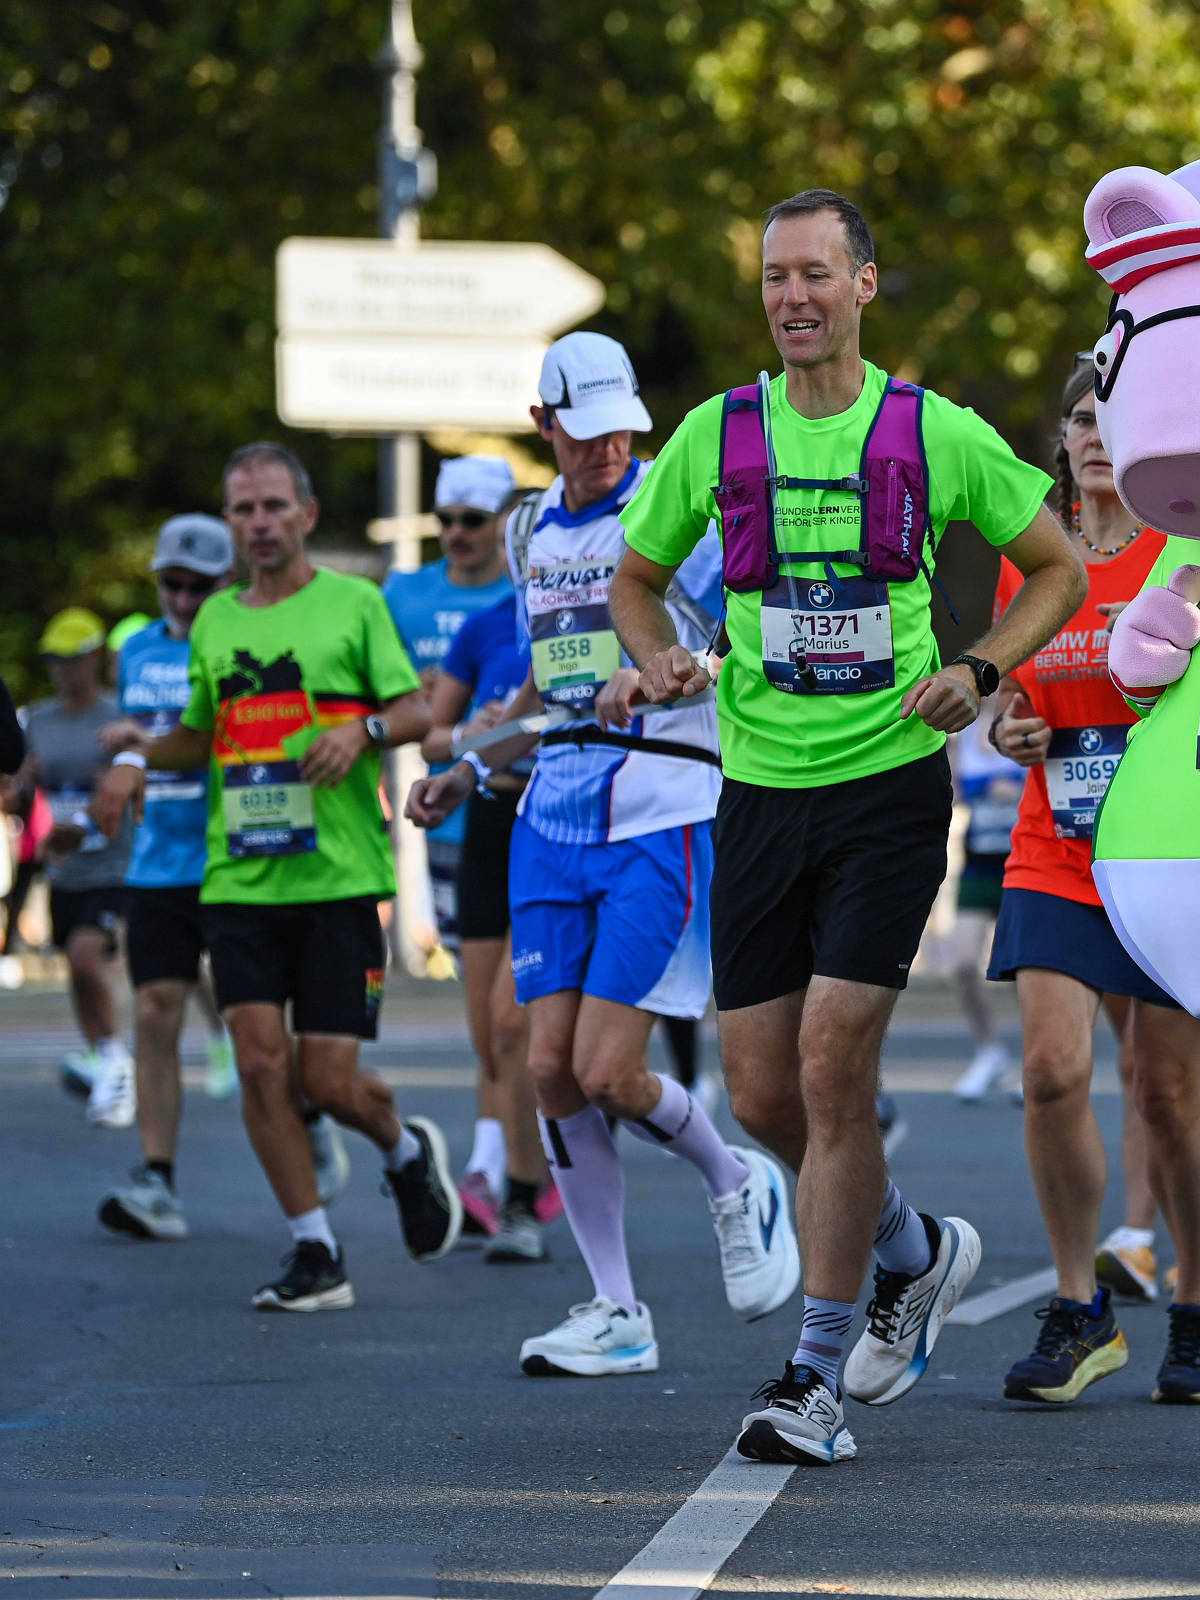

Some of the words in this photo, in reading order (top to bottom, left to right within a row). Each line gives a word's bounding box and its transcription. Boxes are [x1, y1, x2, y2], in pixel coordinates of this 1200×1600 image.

[791, 613, 859, 636] 71371
[549, 638, 590, 662] 5558
[804, 637, 850, 650] Marius
[1034, 652, 1088, 669] BERLIN
[793, 667, 862, 681] zlando
[1064, 760, 1121, 782] 3069
